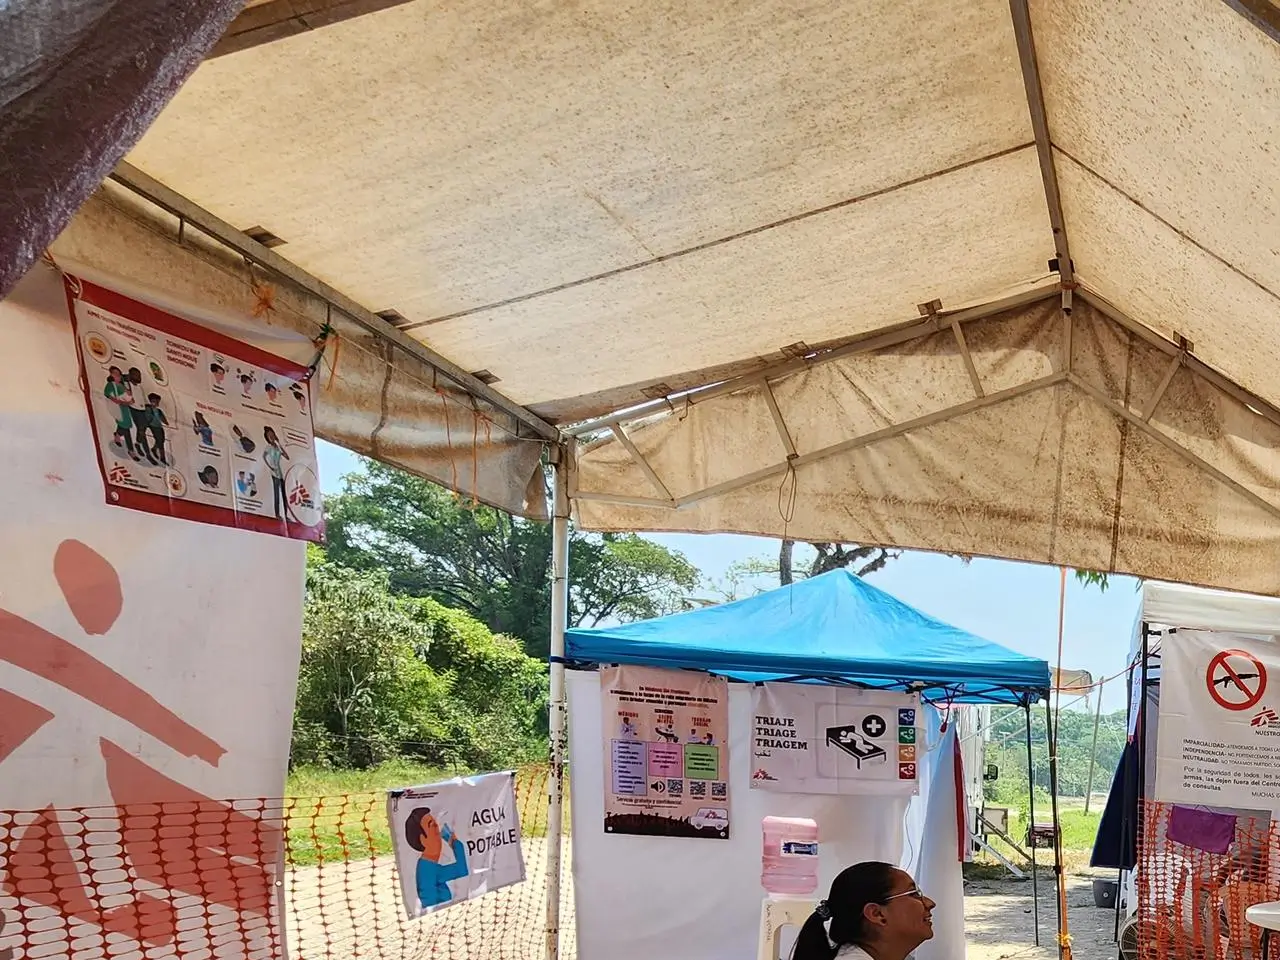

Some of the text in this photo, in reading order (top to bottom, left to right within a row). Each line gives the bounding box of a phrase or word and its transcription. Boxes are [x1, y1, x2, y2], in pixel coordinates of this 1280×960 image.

[755, 715, 794, 727] TRIAJE
[755, 727, 797, 738] TRIAGE
[755, 738, 808, 750] TRIAGEM
[466, 805, 517, 857] AGUA POTABLE
